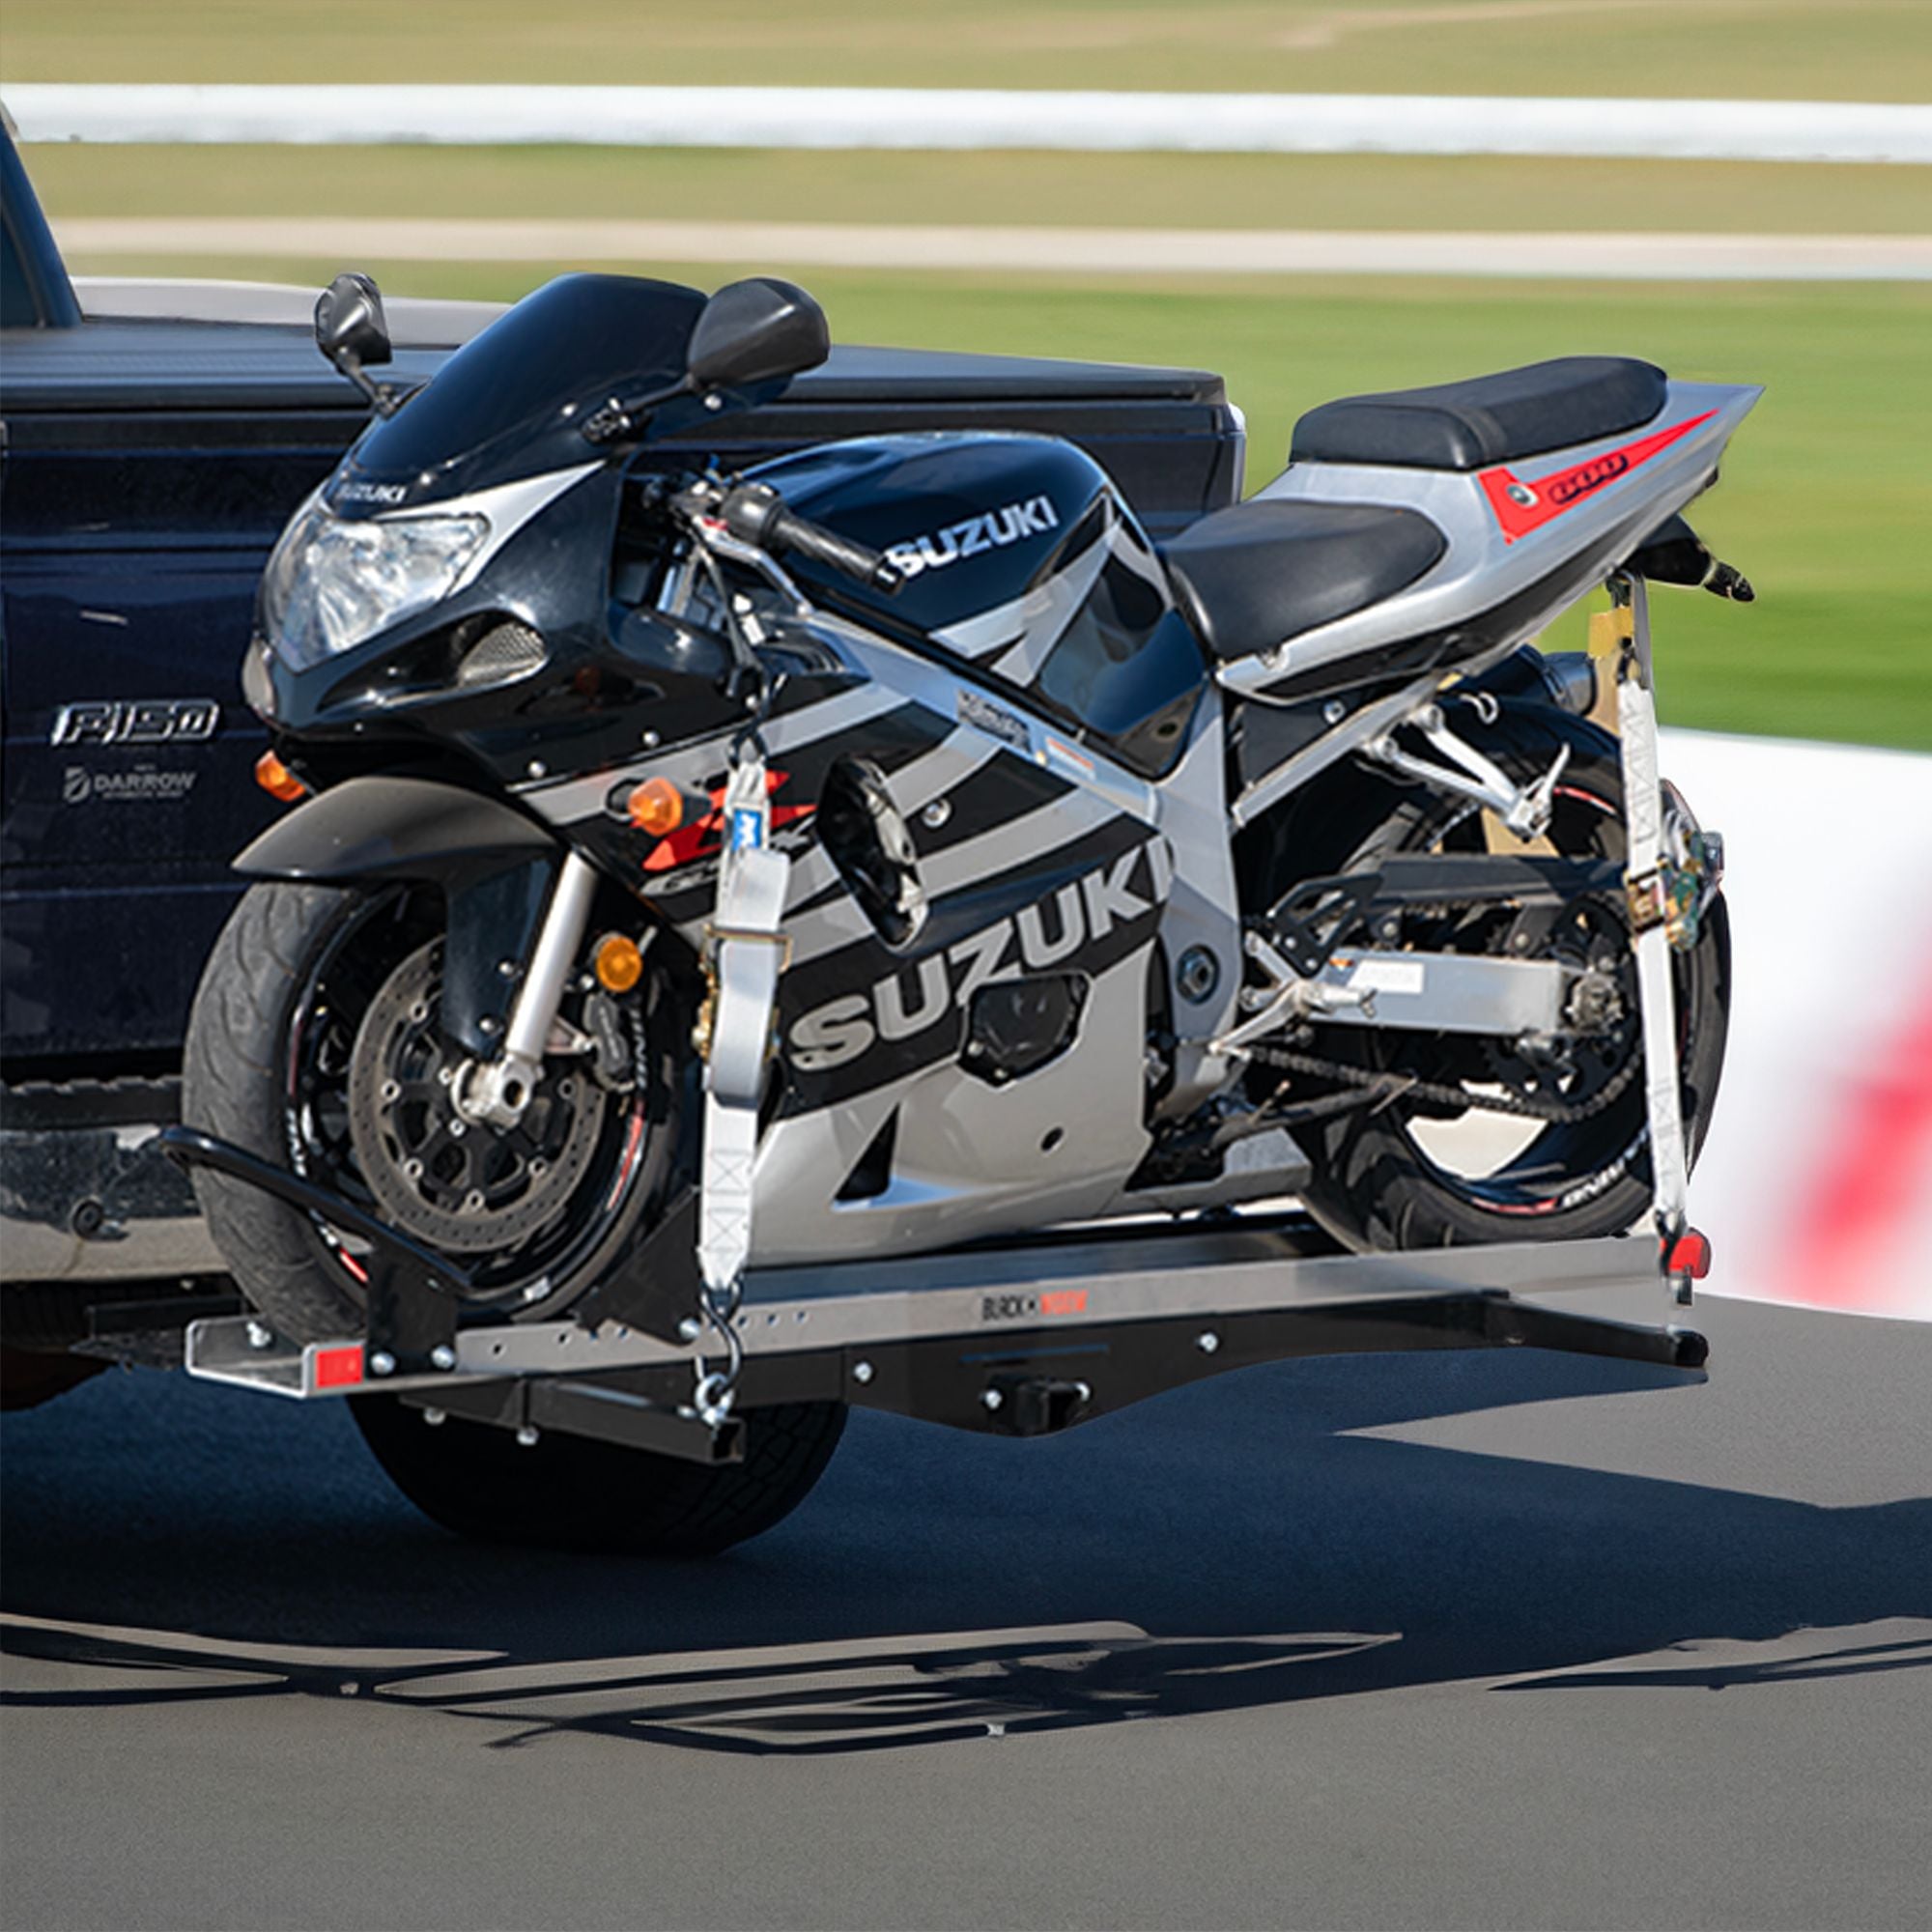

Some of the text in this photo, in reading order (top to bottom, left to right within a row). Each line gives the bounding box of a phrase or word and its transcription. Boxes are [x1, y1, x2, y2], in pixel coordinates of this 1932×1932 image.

[876, 495, 1060, 583] SUZUKI
[94, 772, 197, 792] DARROW
[788, 832, 1176, 1072] SUZUKI
